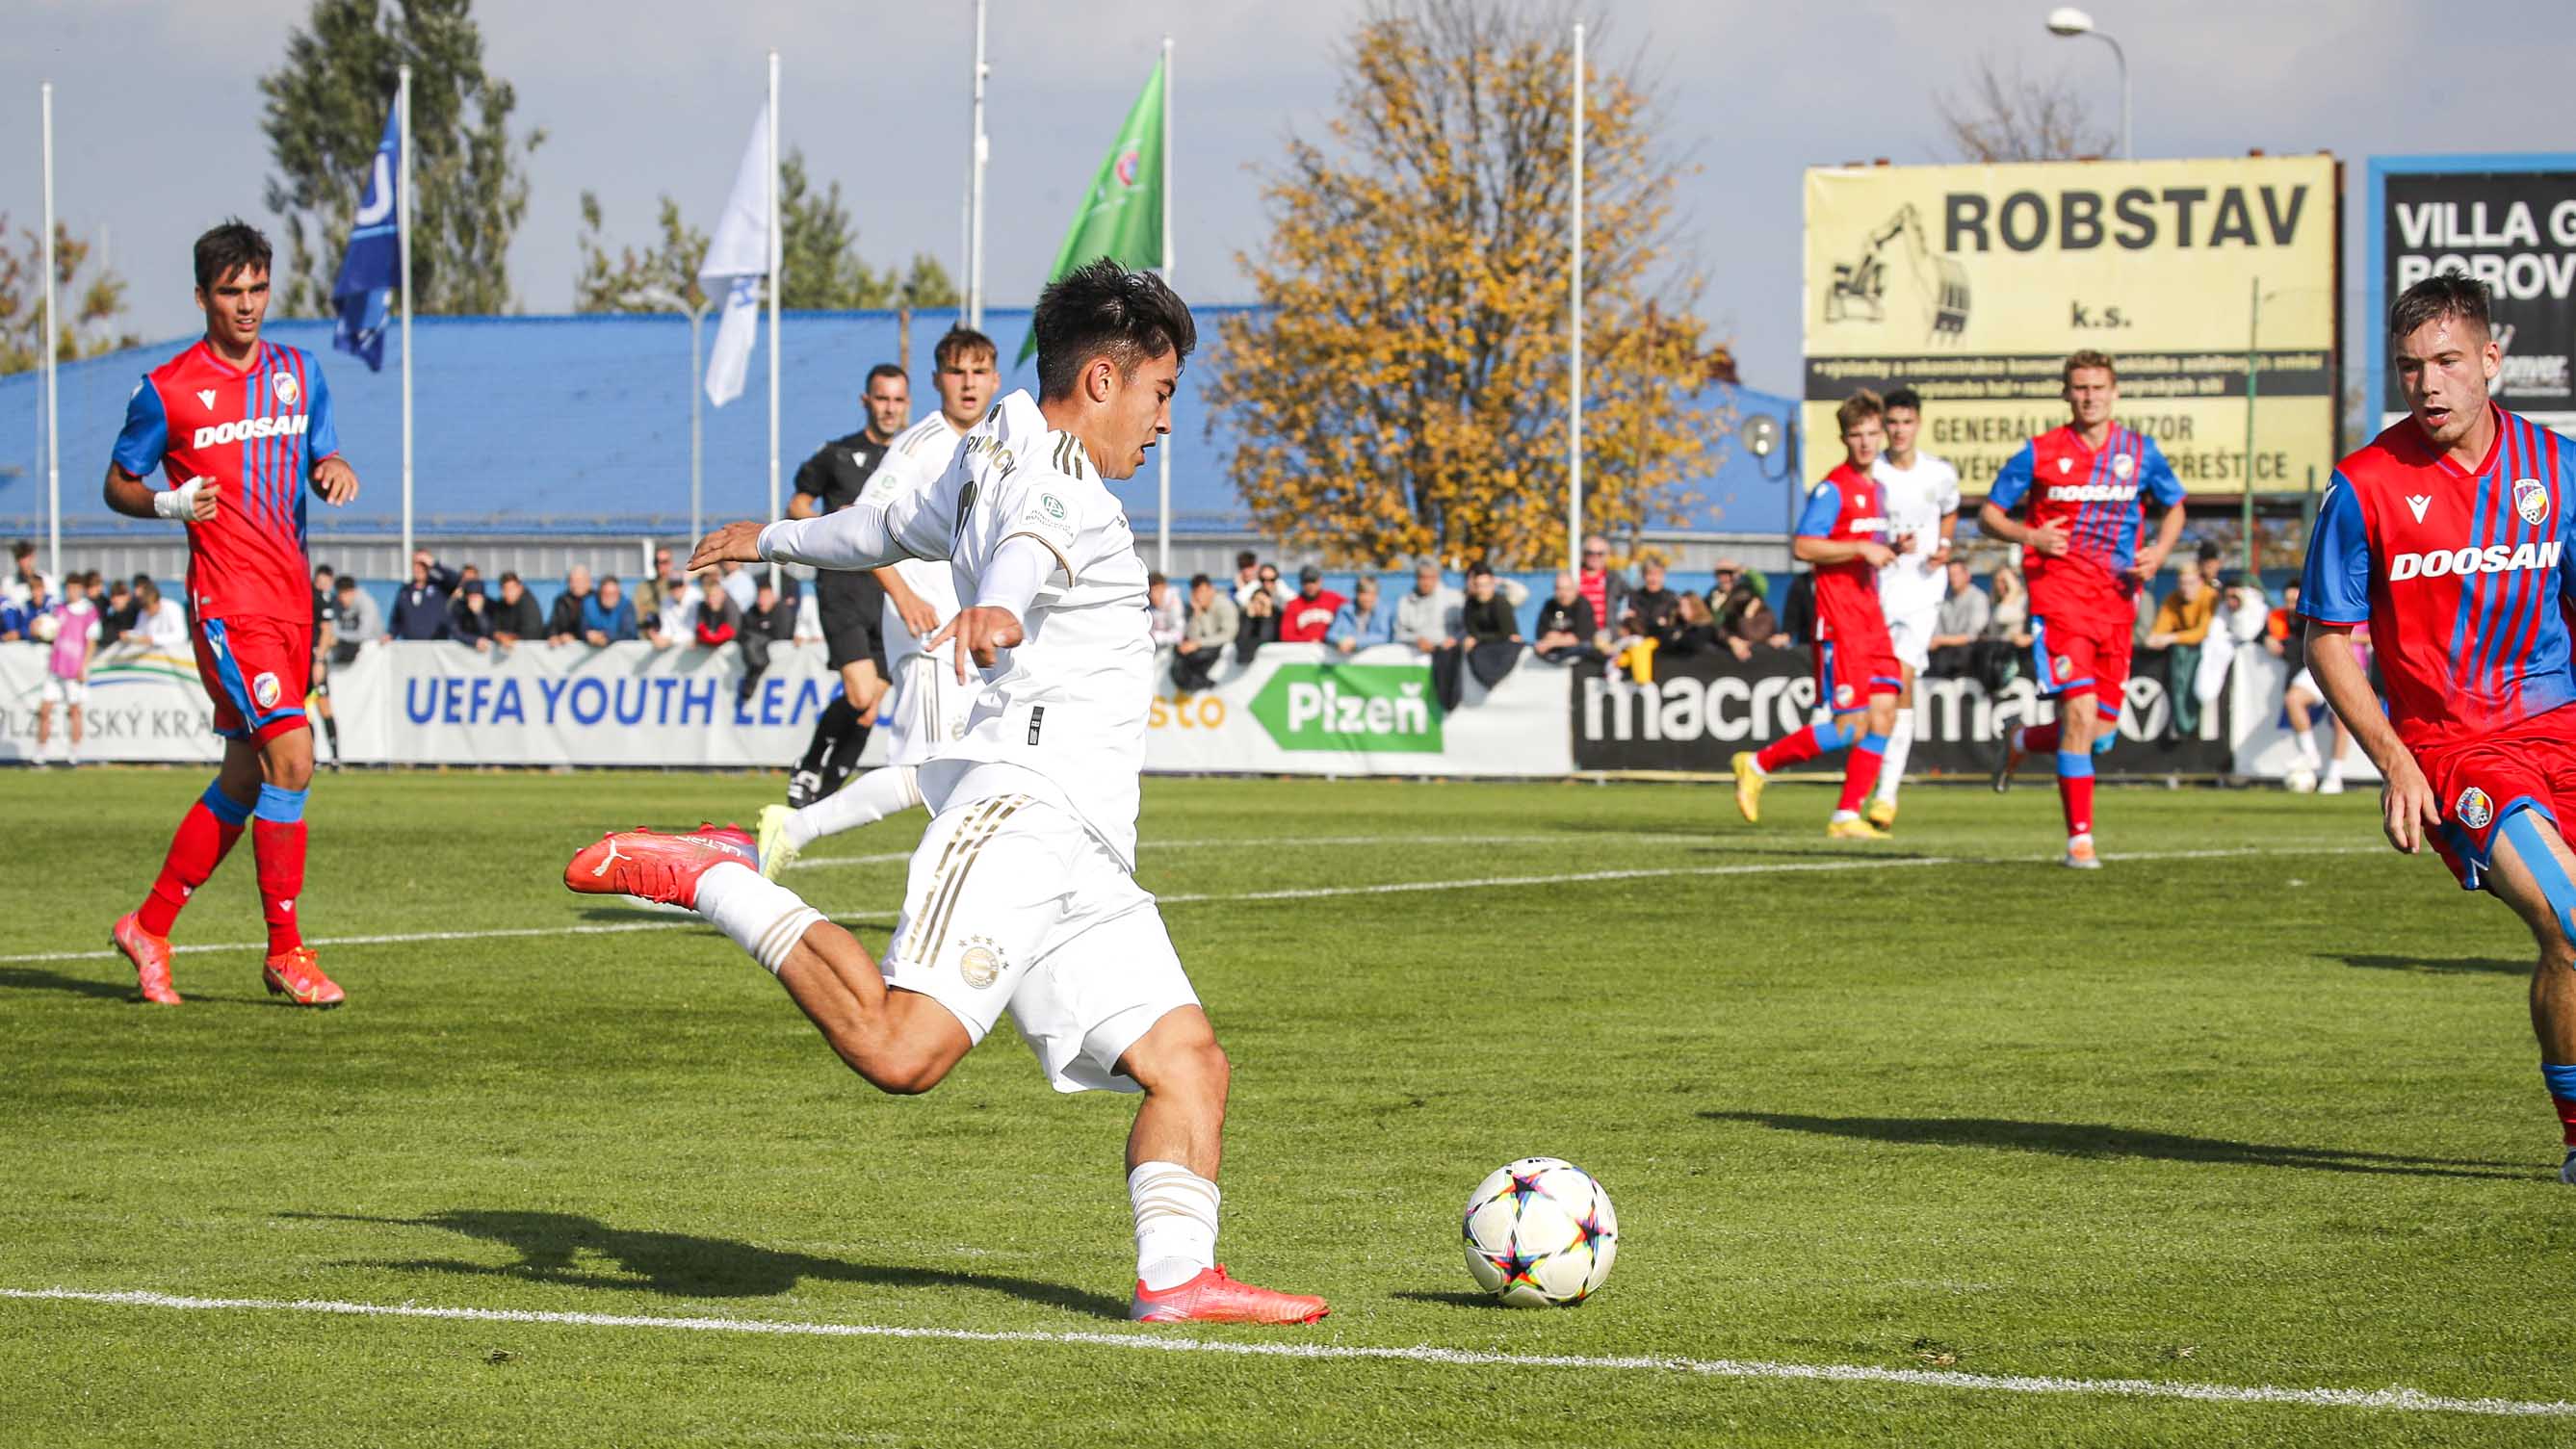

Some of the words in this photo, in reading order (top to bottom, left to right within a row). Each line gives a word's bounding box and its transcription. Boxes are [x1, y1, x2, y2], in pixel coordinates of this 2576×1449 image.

[1945, 184, 2308, 253] ROBSTAV
[2395, 201, 2539, 247] VILLA
[2070, 301, 2132, 329] k.s.
[193, 415, 308, 450] DOOSAN
[2389, 541, 2563, 582] DOOSAN
[405, 678, 524, 725] UEFA
[539, 678, 717, 726] YOUTH
[1149, 689, 1226, 729] sto
[1288, 682, 1428, 734] Plzeň
[1584, 676, 1832, 741] macro
